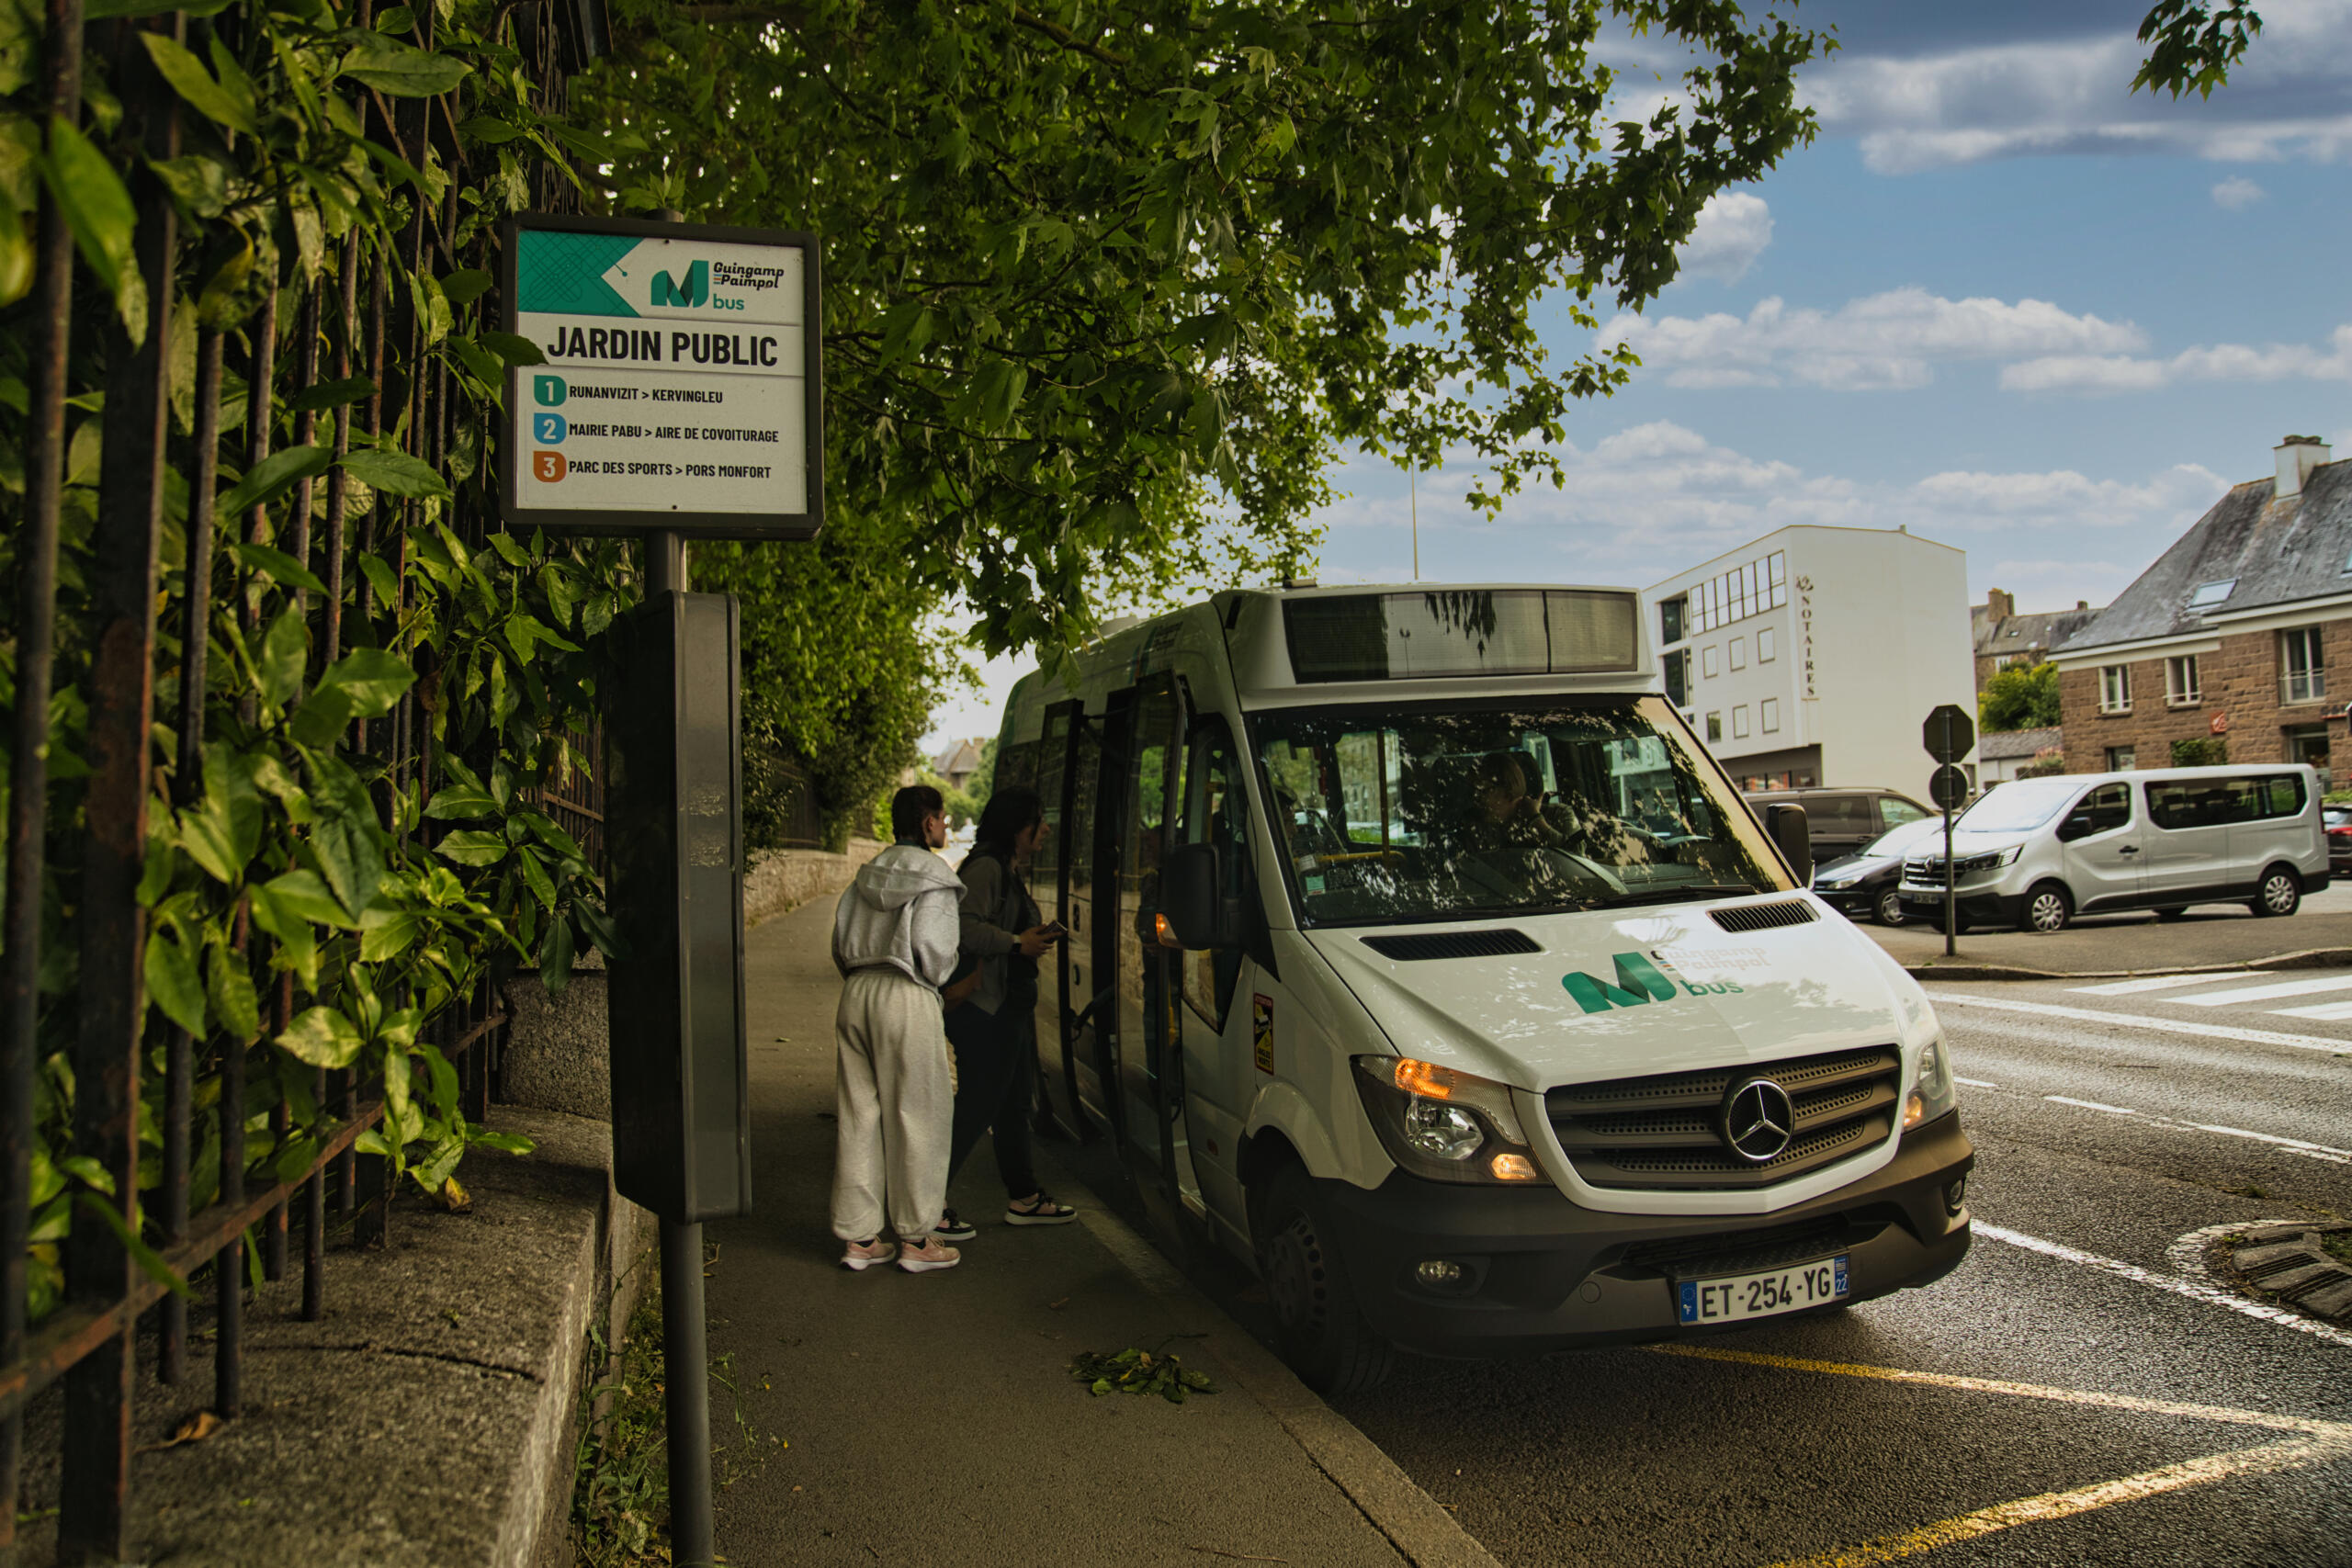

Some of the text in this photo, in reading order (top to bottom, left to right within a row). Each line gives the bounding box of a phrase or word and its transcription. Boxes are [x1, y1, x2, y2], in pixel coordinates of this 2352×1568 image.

[713, 262, 785, 278] Guingamp
[721, 273, 780, 291] Paimpol
[713, 293, 745, 310] bus
[547, 327, 778, 367] JARDIN PUBLIC
[545, 381, 554, 401] 1
[569, 385, 639, 400] RUNANVIZIT
[652, 389, 723, 403] KERVINGLEU
[543, 418, 557, 440] 2
[569, 423, 609, 437] MAIRIE
[611, 424, 642, 438] PABU
[655, 426, 682, 440] AIRE
[684, 427, 699, 440] DE
[701, 427, 779, 443] COVOITURAGE
[543, 457, 556, 479] 3
[569, 460, 600, 474] PARC
[602, 461, 625, 475] DES
[628, 462, 673, 476] SPORTS
[685, 464, 716, 477] PORS
[718, 465, 772, 479] MONFORT
[1801, 595, 1815, 696] NOTAIRES
[1679, 979, 1744, 997] bus
[1702, 1267, 1831, 1318] ET-254-YG
[1836, 1278, 1848, 1293] 22
